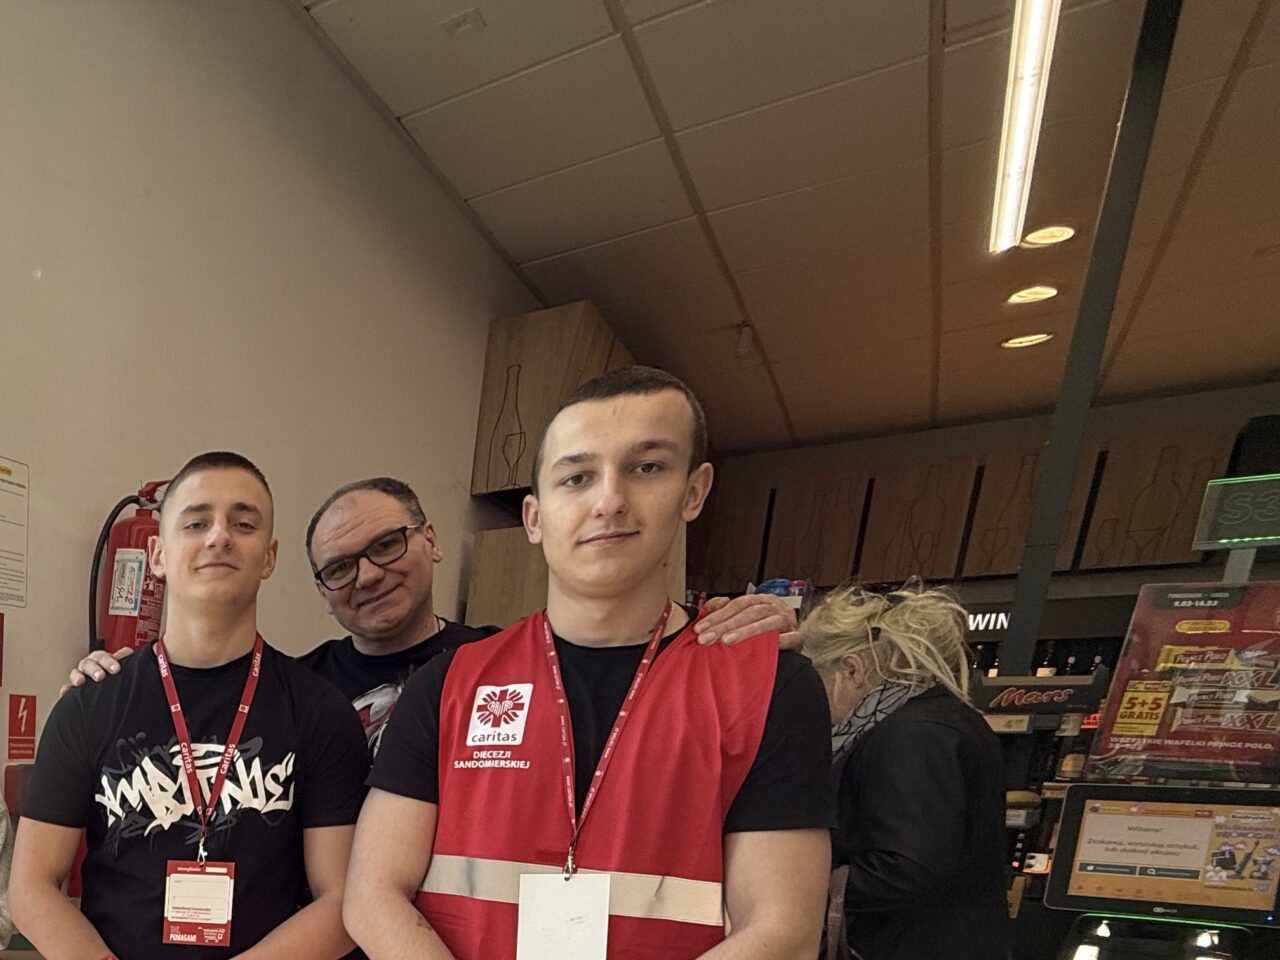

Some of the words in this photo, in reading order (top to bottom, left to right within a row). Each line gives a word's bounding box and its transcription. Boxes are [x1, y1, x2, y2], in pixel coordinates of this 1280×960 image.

[157, 654, 168, 678] caritas
[252, 652, 262, 677] caritas
[1221, 671, 1277, 689] XXL
[989, 687, 1074, 708] Mars
[1123, 696, 1163, 710] 5+5
[1120, 710, 1160, 720] GRATIS
[471, 731, 517, 742] caritas
[181, 742, 193, 774] caritas
[220, 743, 236, 774] caritas
[473, 750, 512, 759] DIECEZJI
[453, 760, 530, 769] SANDOMIERSKIEJ
